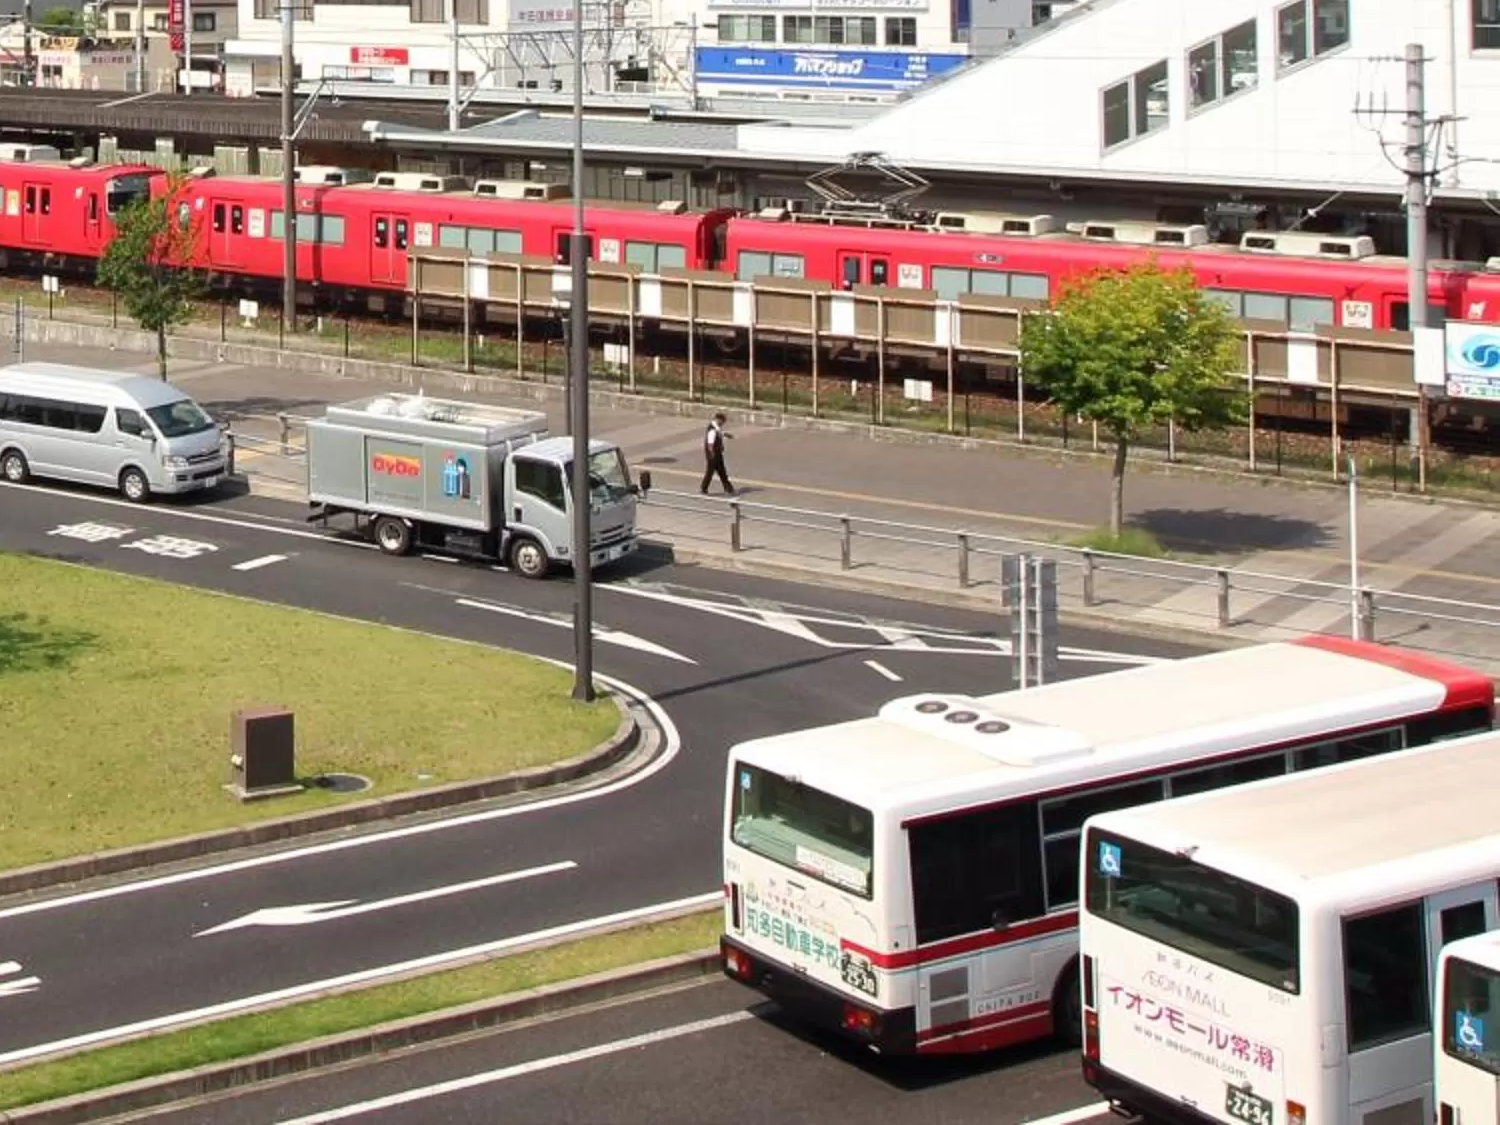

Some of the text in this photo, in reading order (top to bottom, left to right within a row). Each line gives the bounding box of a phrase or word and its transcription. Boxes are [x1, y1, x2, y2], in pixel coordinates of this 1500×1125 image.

[1107, 986, 1276, 1073] イオンモール常滑
[1185, 985, 1232, 1018] MALL
